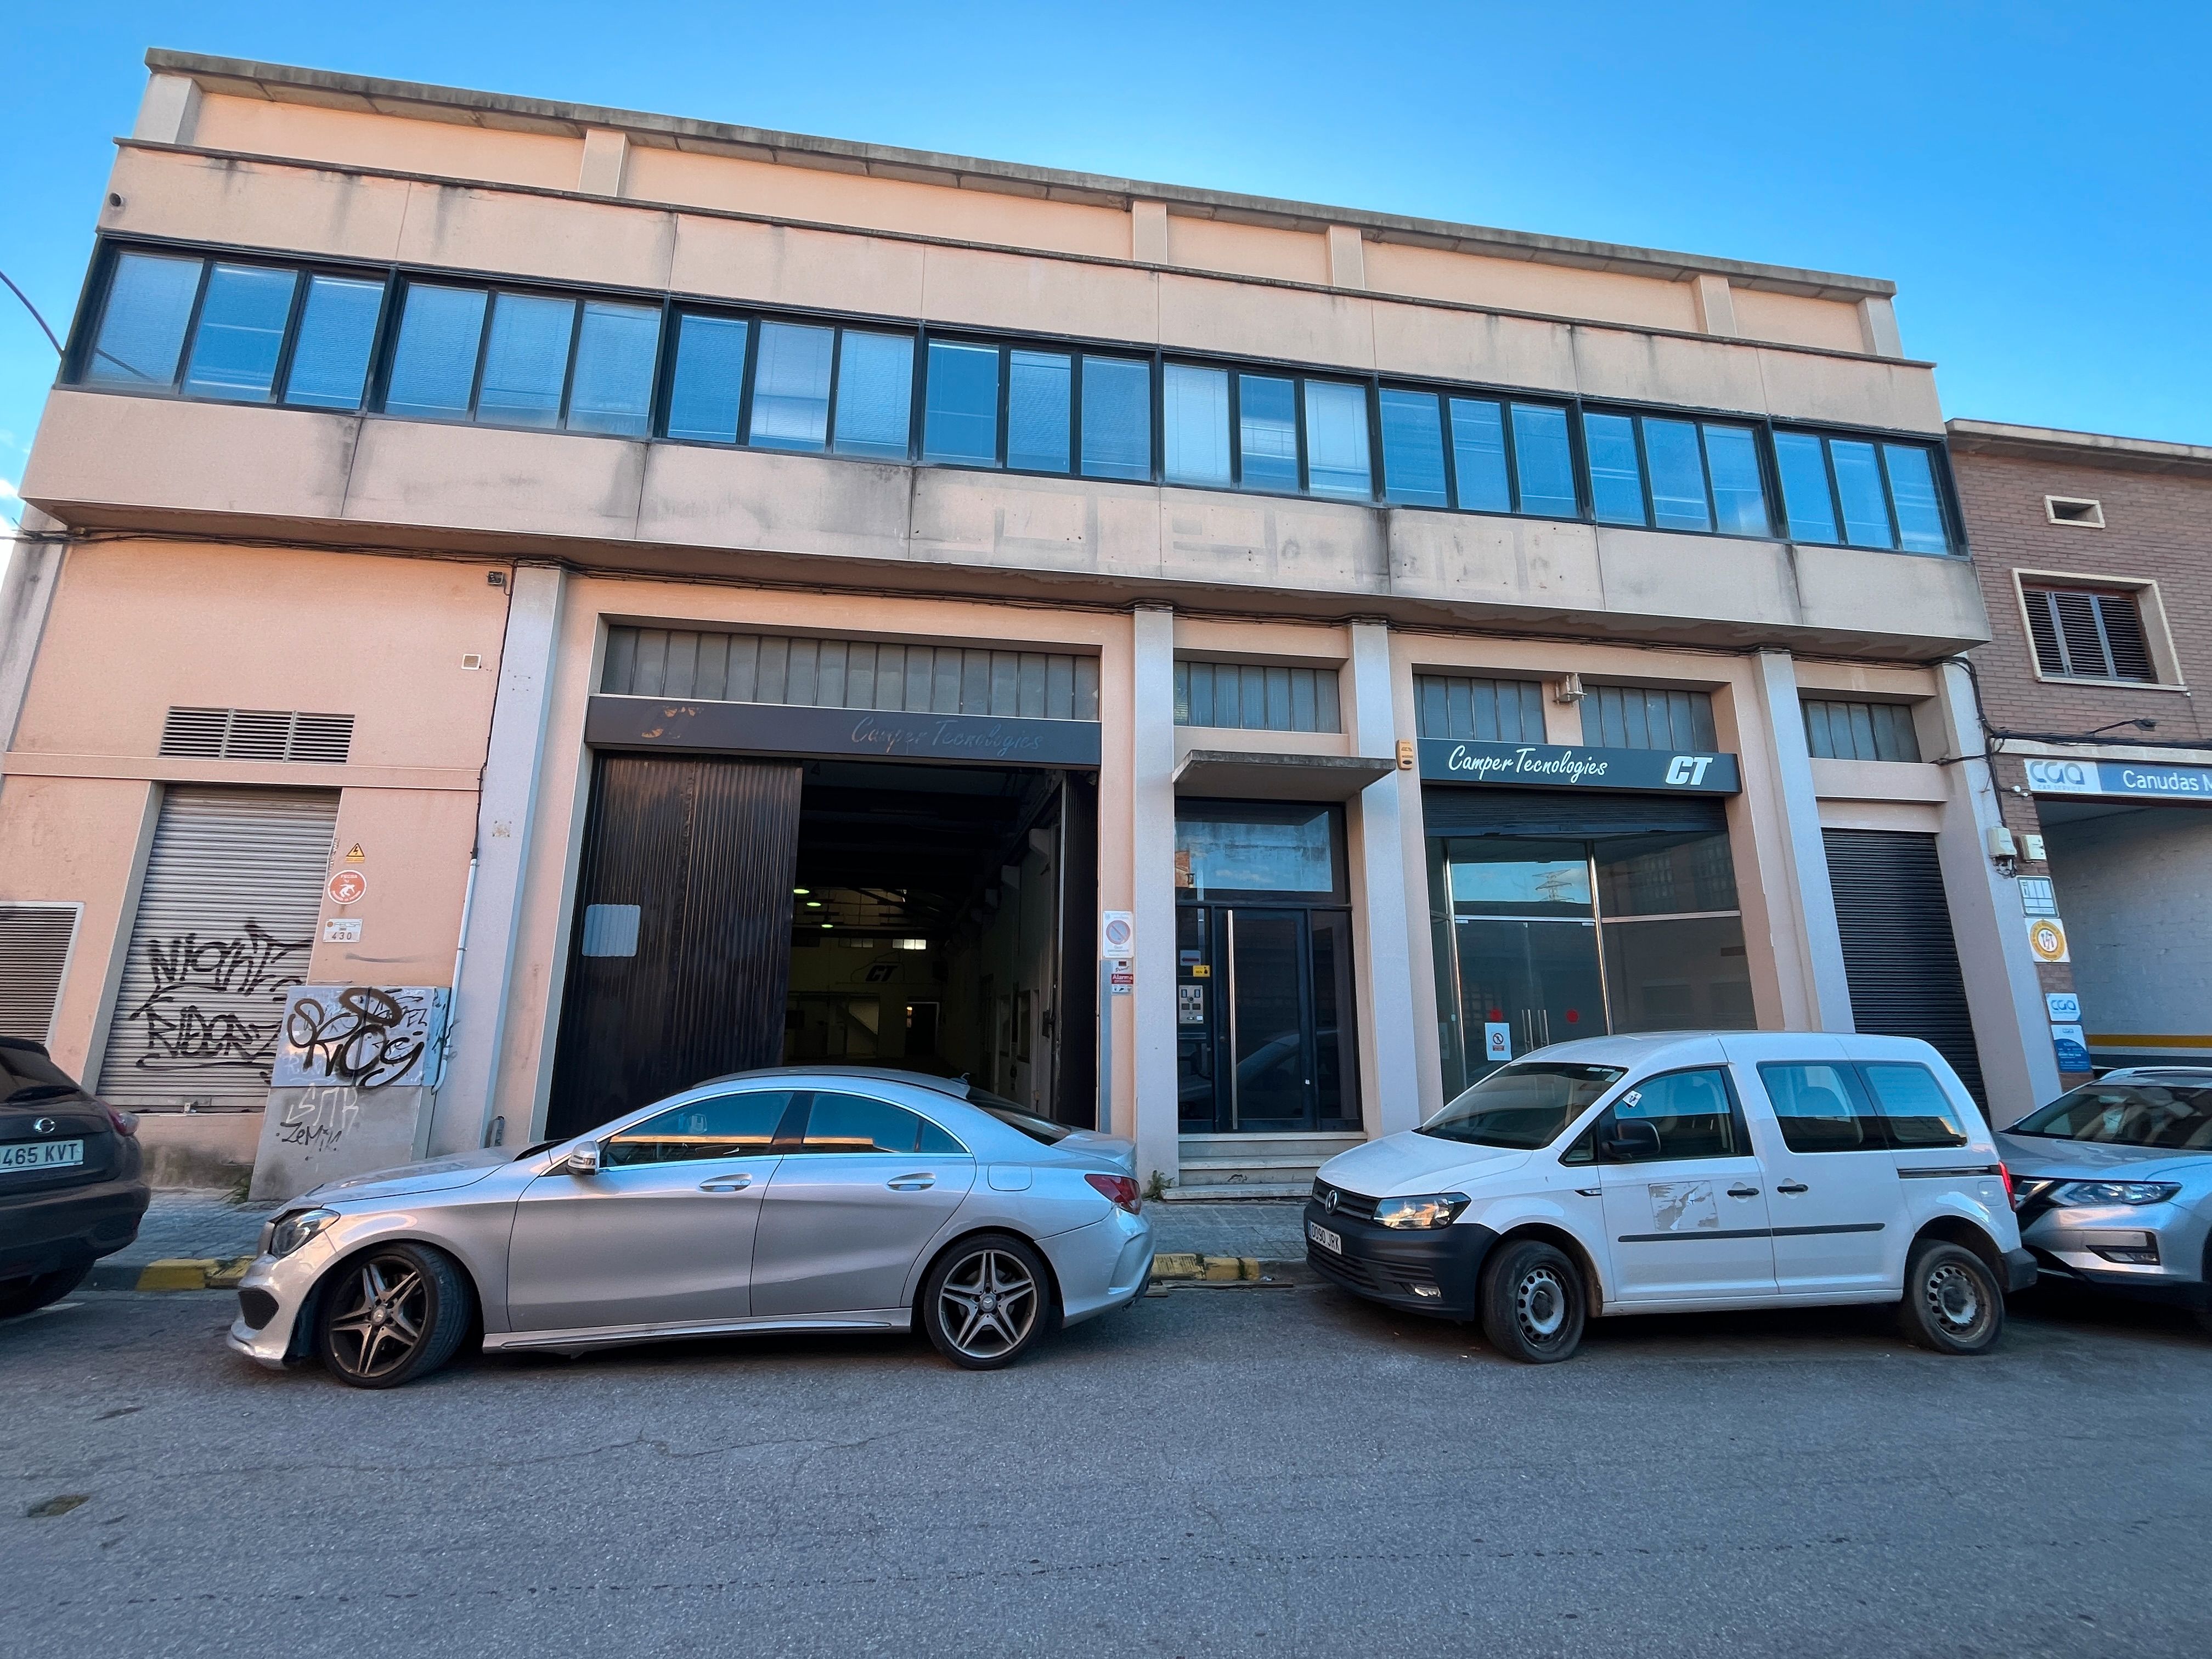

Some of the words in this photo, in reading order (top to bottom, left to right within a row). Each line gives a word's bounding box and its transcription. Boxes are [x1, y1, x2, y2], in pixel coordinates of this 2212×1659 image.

[1448, 745, 1514, 780] Camper
[1516, 748, 1607, 783] Tecnologies
[1666, 755, 1713, 785] CT
[2123, 770, 2199, 791] Canudas
[866, 965, 899, 981] CT
[0, 1148, 38, 1166] 465
[45, 1143, 77, 1163] KVT
[1328, 1233, 1340, 1251] JRK
